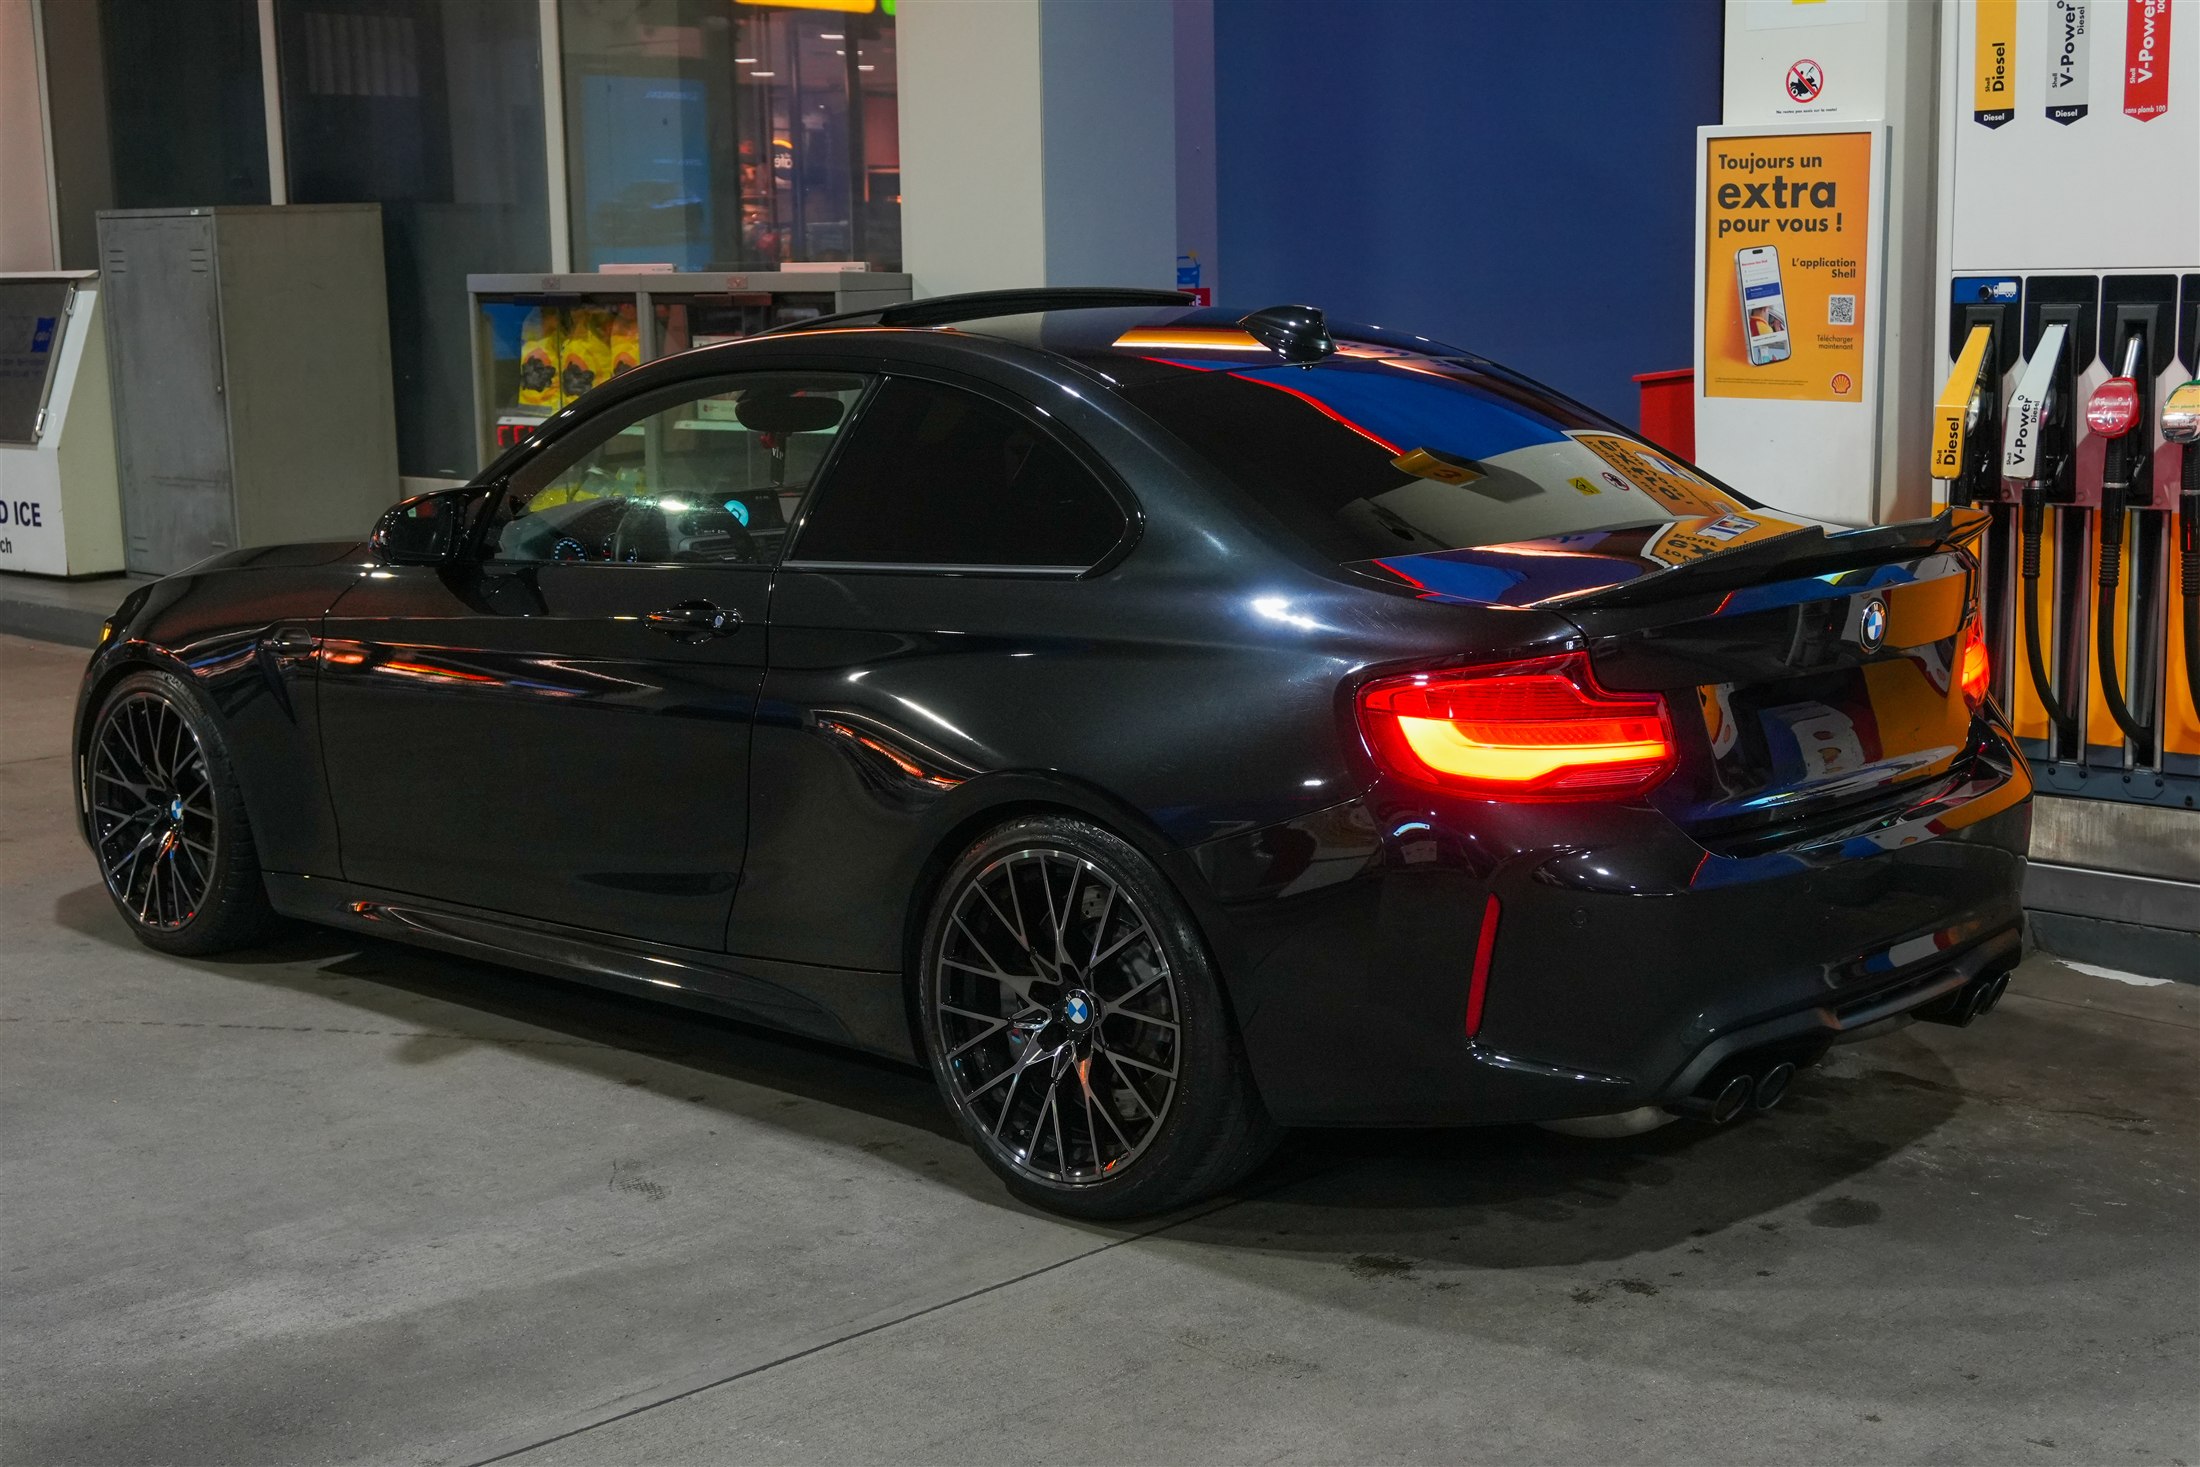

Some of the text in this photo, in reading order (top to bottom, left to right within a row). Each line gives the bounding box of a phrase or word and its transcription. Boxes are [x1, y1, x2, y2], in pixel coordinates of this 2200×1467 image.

[2077, 6, 2085, 35] Diesel
[2060, 4, 2076, 87] V-Power
[1992, 42, 2005, 92] Diesel
[1983, 113, 2005, 121] Diesel
[2055, 109, 2078, 118] Diesel
[2137, 106, 2154, 115] plomb
[1718, 152, 1822, 174] Toujours un
[1717, 175, 1837, 210] extra
[1718, 212, 1842, 239] pour vous !
[1792, 257, 1856, 269] L'application
[1831, 269, 1856, 278] Shell
[1817, 334, 1853, 343] Télécharger
[2030, 400, 2040, 423] Diesel
[1944, 417, 1960, 466] Diesel
[2013, 397, 2033, 465] V-Power
[14, 501, 42, 527] ICE
